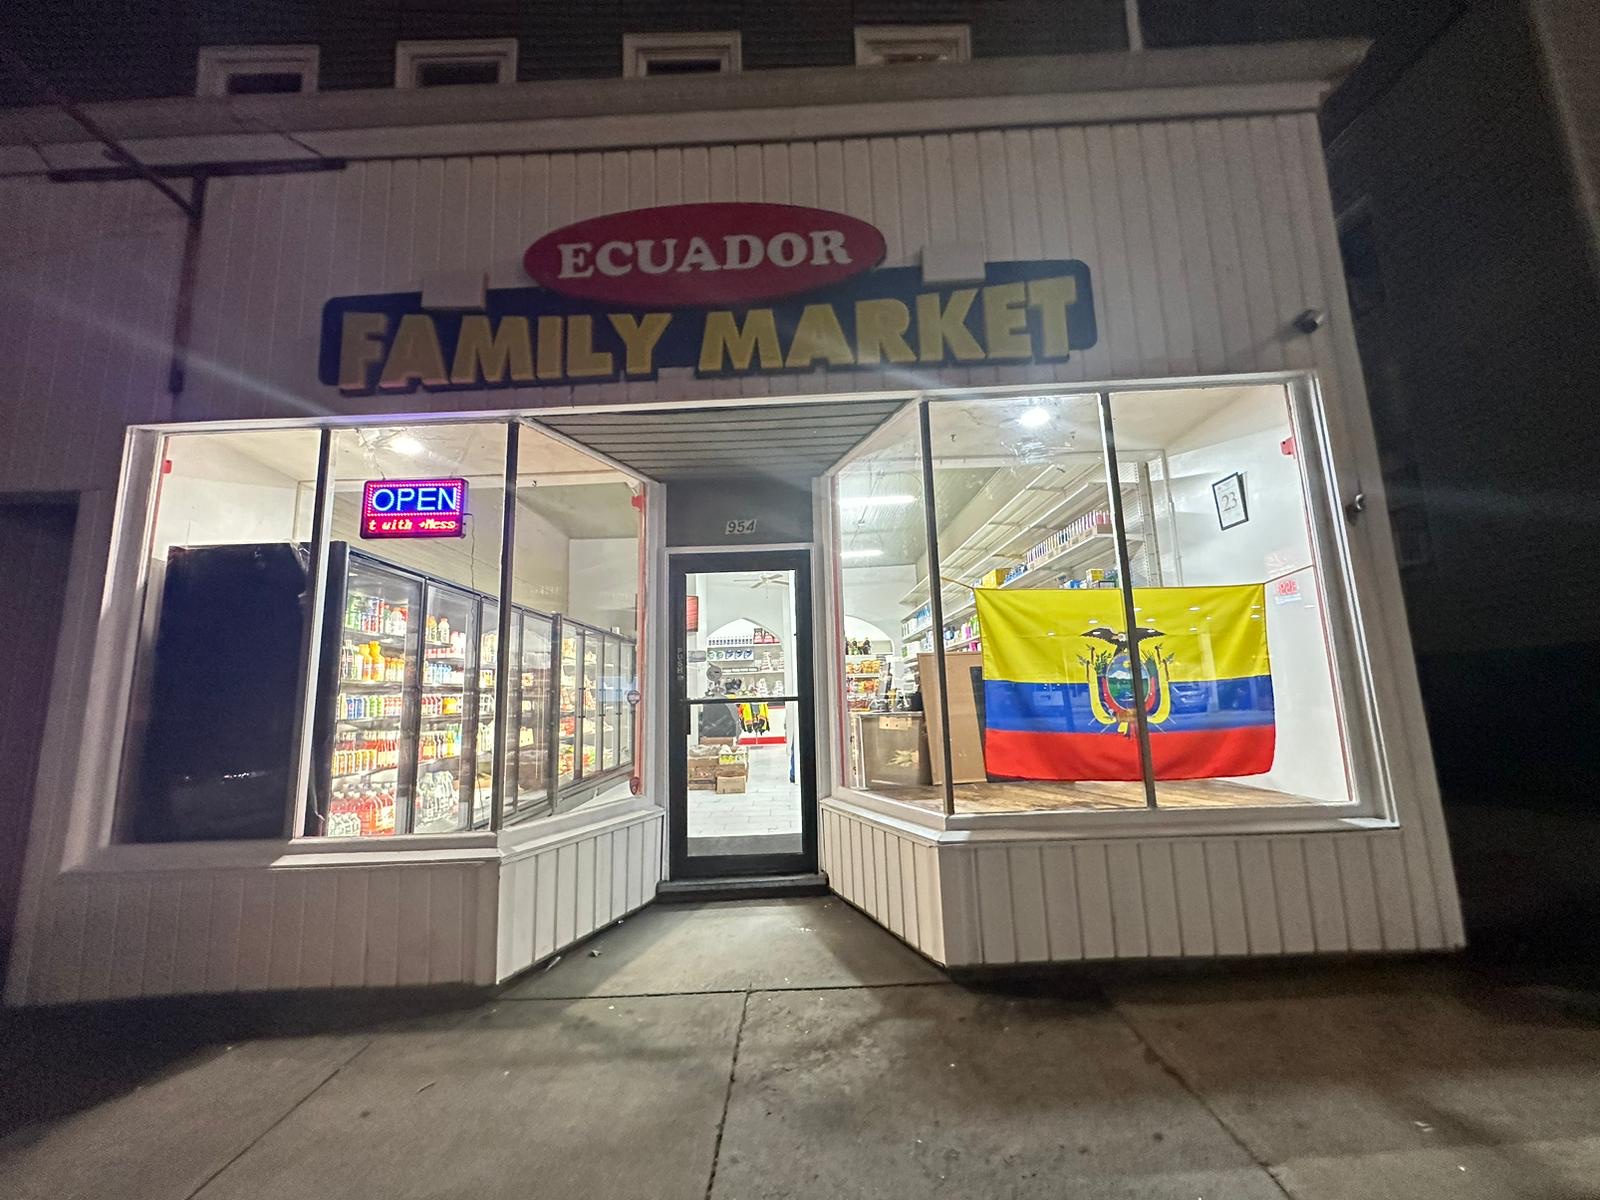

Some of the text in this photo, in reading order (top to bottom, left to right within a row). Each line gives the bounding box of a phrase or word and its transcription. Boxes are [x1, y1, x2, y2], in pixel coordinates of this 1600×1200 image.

[557, 230, 852, 279] ECUADOR
[338, 275, 1077, 392] FAMILY MARKET
[372, 487, 457, 511] OPEN
[728, 520, 755, 533] 954
